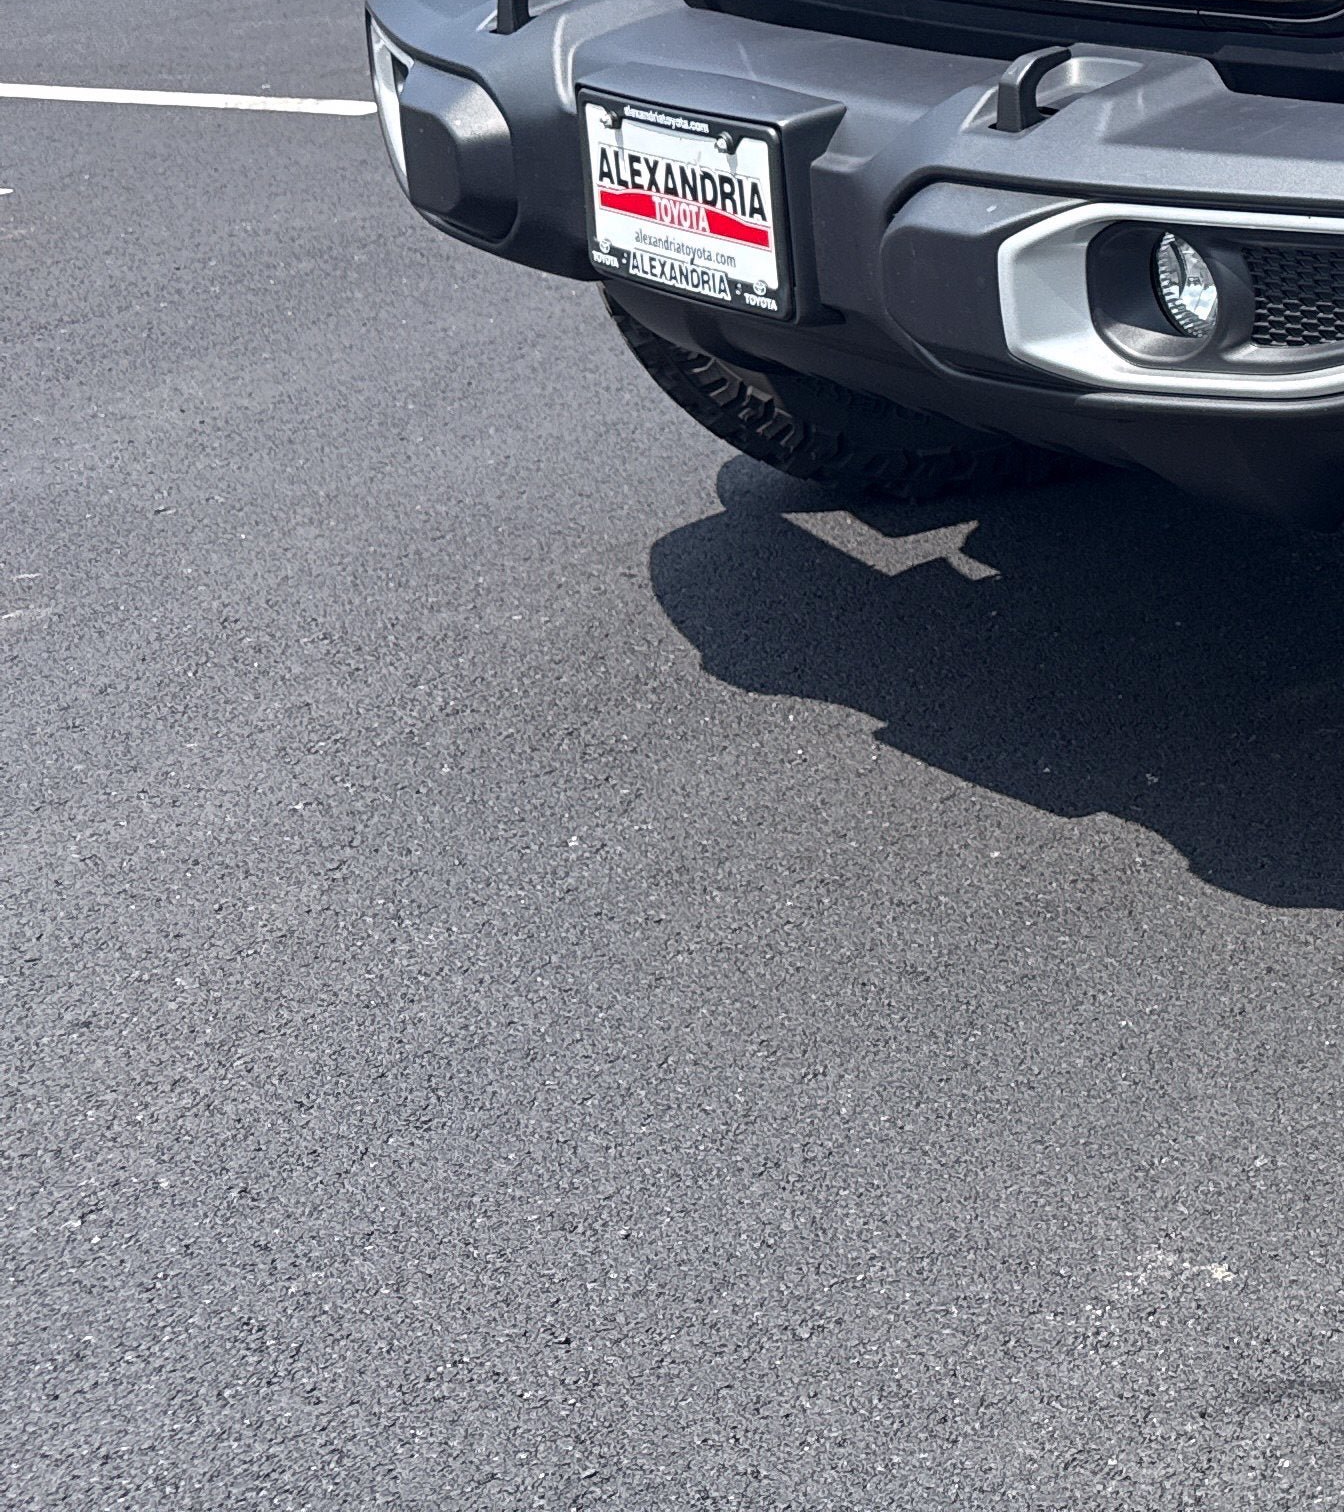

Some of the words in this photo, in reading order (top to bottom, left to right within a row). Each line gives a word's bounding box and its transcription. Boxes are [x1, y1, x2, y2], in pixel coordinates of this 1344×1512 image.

[623, 105, 709, 133] alexandriatoyota.com
[599, 147, 768, 222] ALEXANDRIA
[652, 197, 711, 233] TOYOTA
[592, 250, 620, 269] TOYOTA
[634, 228, 737, 268] alexandriatoyota.com
[630, 251, 731, 300] ALEXANDRIA
[744, 293, 778, 311] TOYOTA
